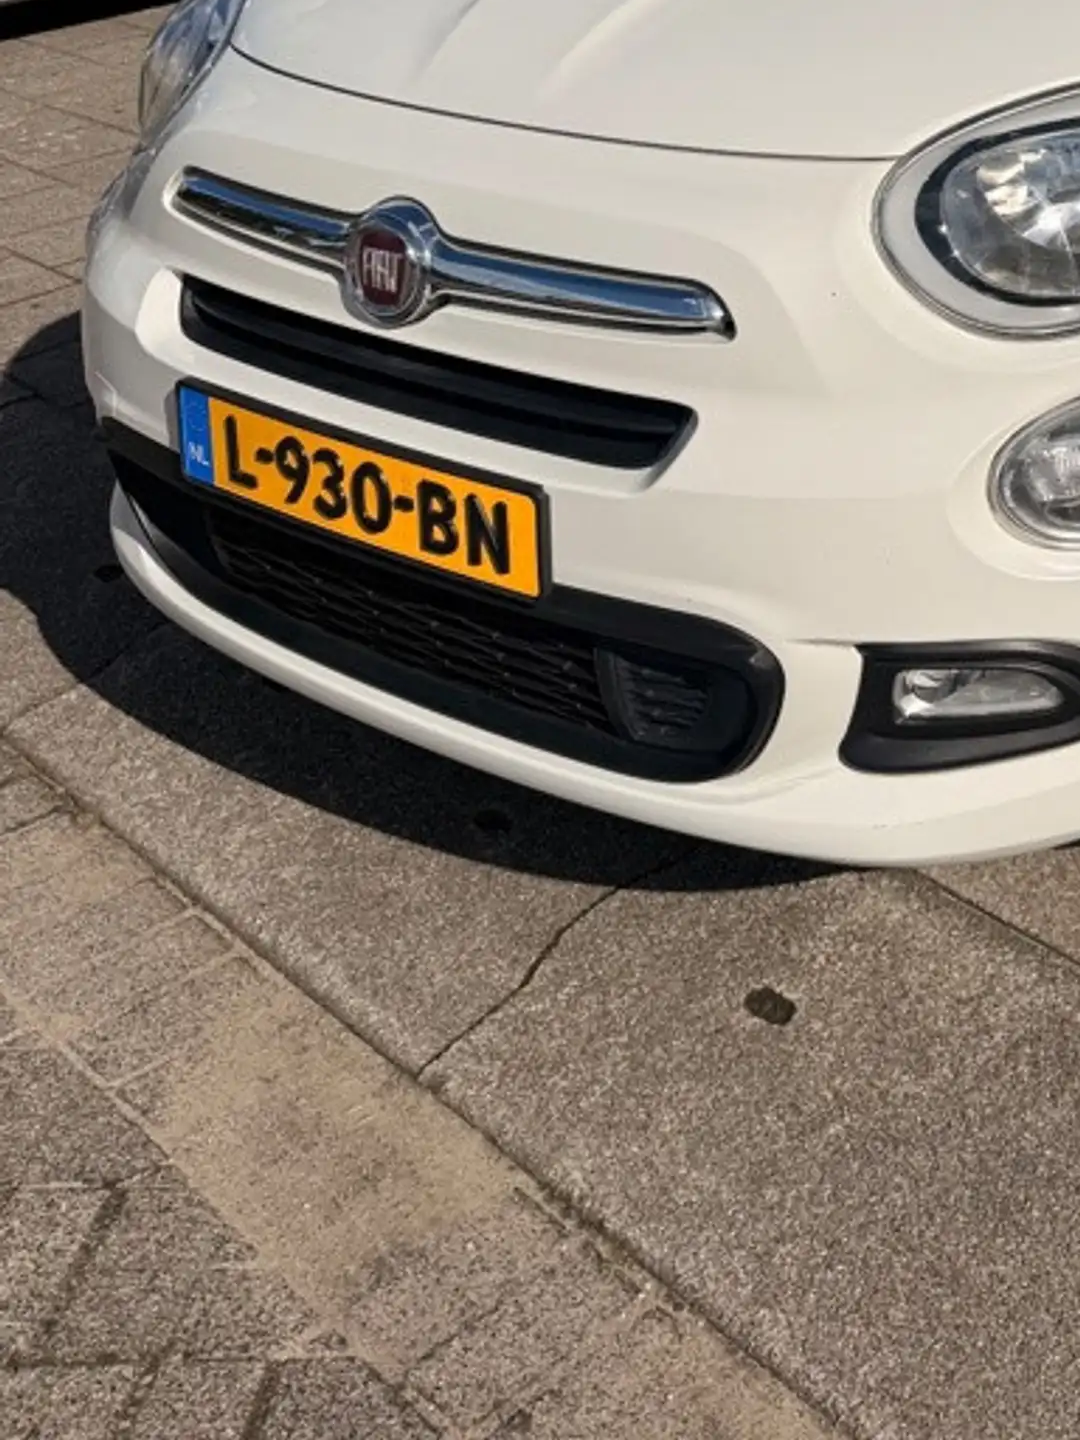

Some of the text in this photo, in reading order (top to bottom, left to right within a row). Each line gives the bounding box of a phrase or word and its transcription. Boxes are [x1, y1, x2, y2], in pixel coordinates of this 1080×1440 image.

[362, 245, 404, 293] FIAT
[188, 441, 209, 466] NL
[223, 415, 511, 575] L-930-BN
